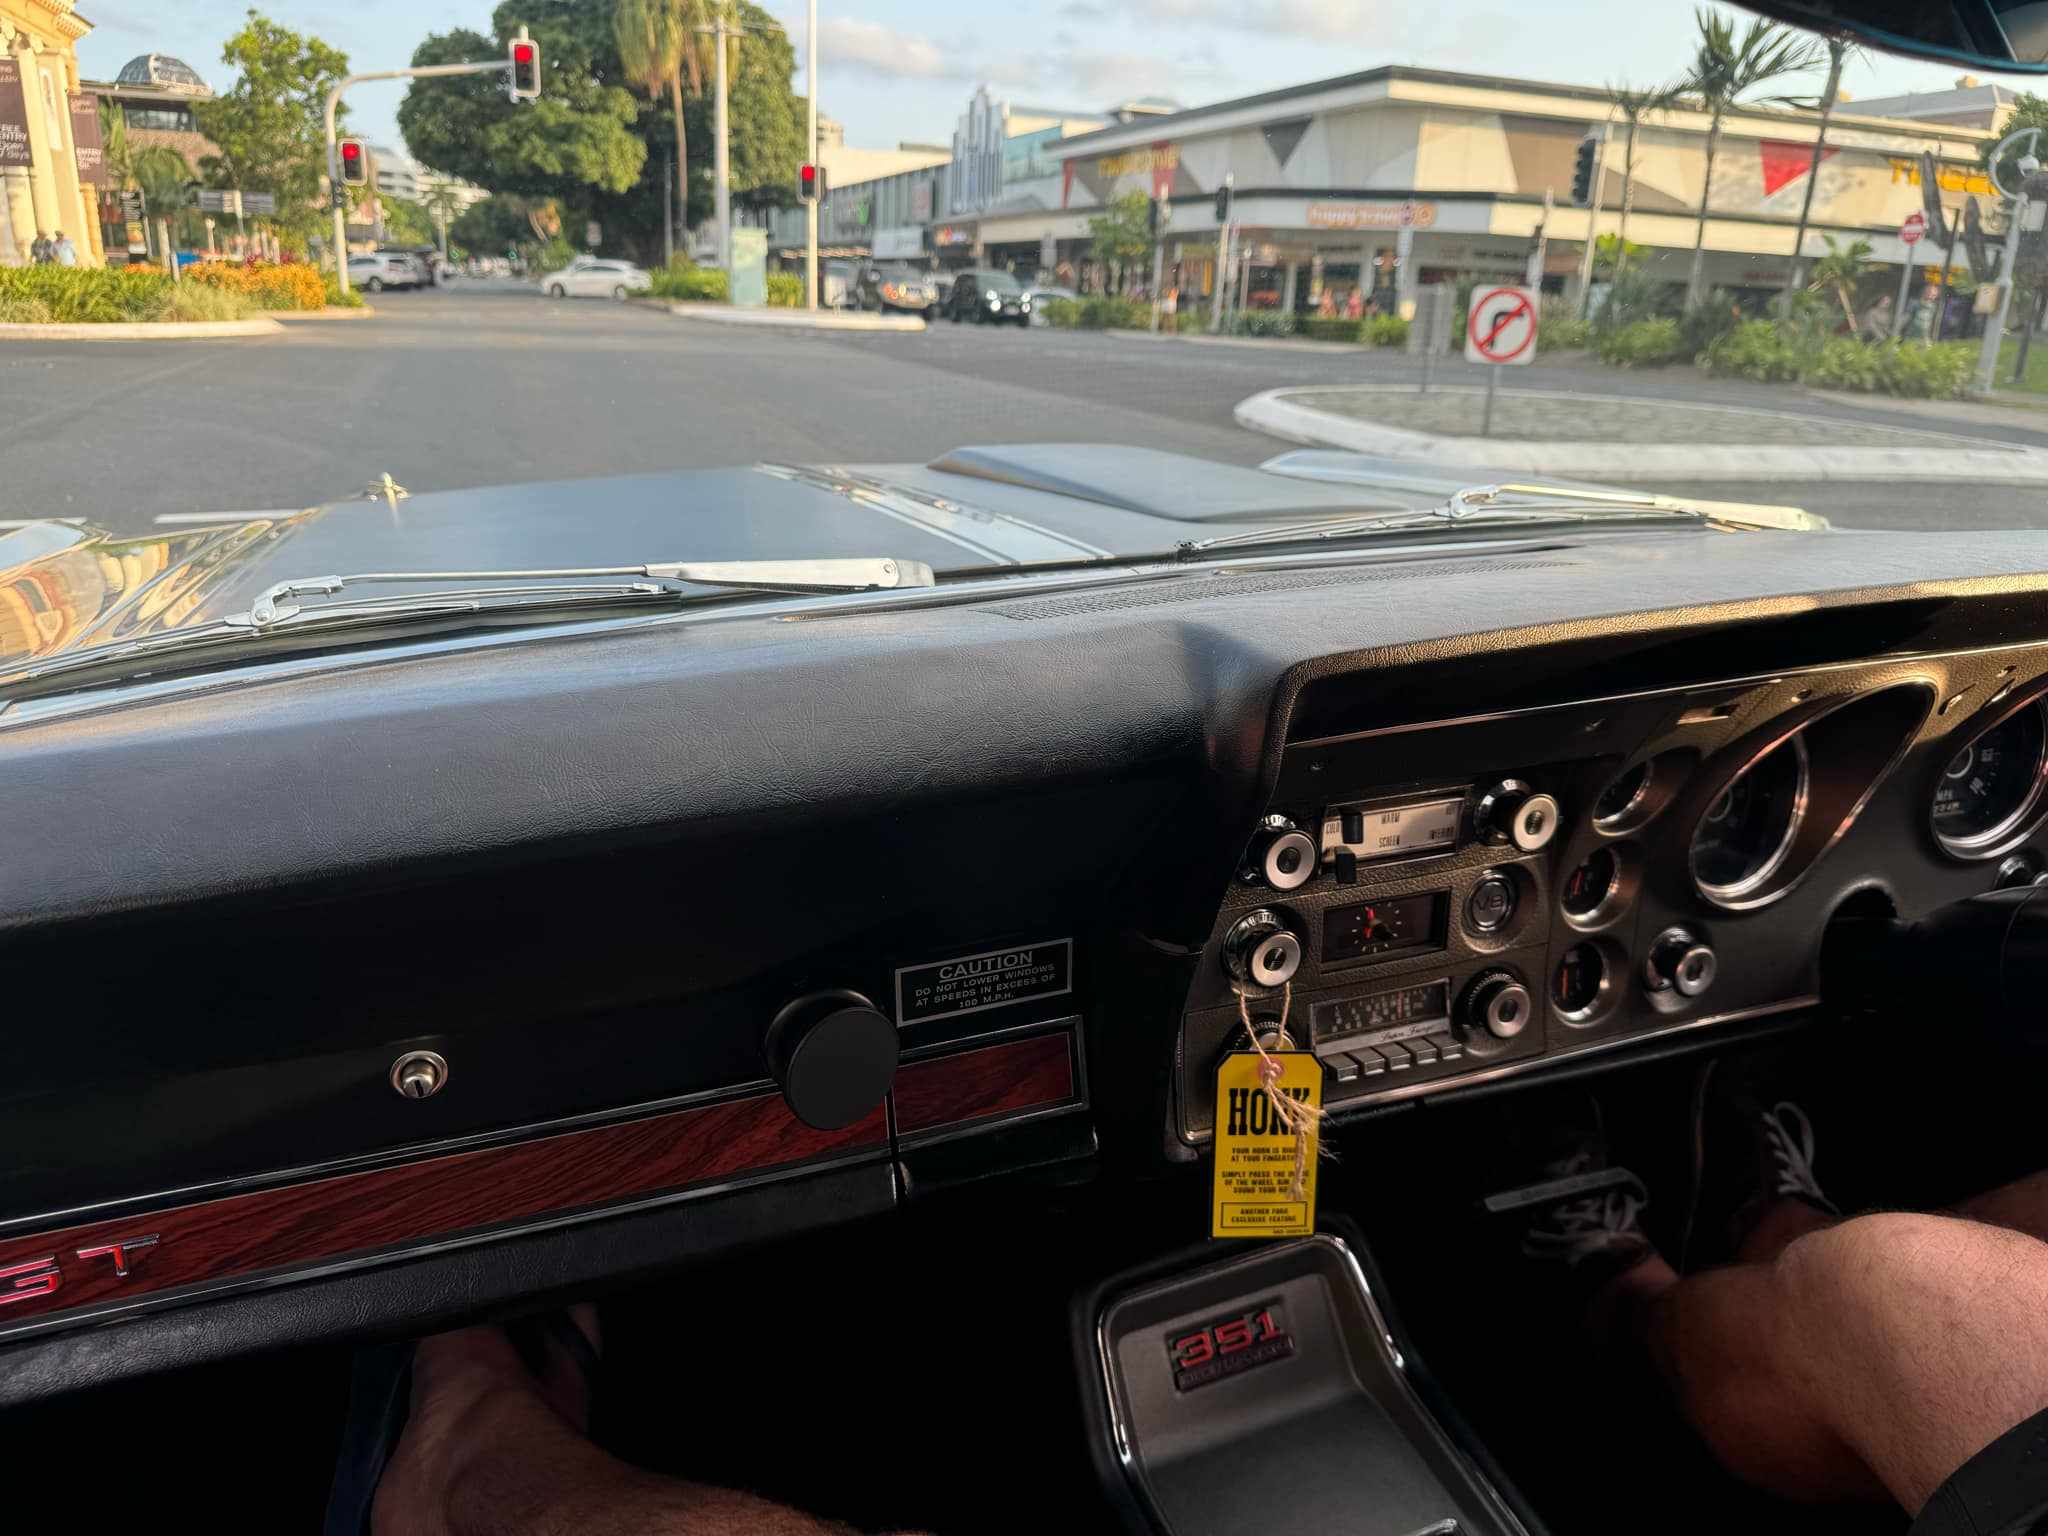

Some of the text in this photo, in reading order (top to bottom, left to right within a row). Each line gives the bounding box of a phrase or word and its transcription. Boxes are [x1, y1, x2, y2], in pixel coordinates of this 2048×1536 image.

[1475, 895, 1504, 910] V8
[939, 951, 1033, 979] CAUTION
[915, 964, 1056, 997] DO NOT LOWER WINDOWS
[915, 974, 1056, 1008] AT SPEEDS IN EXCESS OF
[959, 999, 978, 1008] 100
[1174, 1310, 1282, 1368] 351
